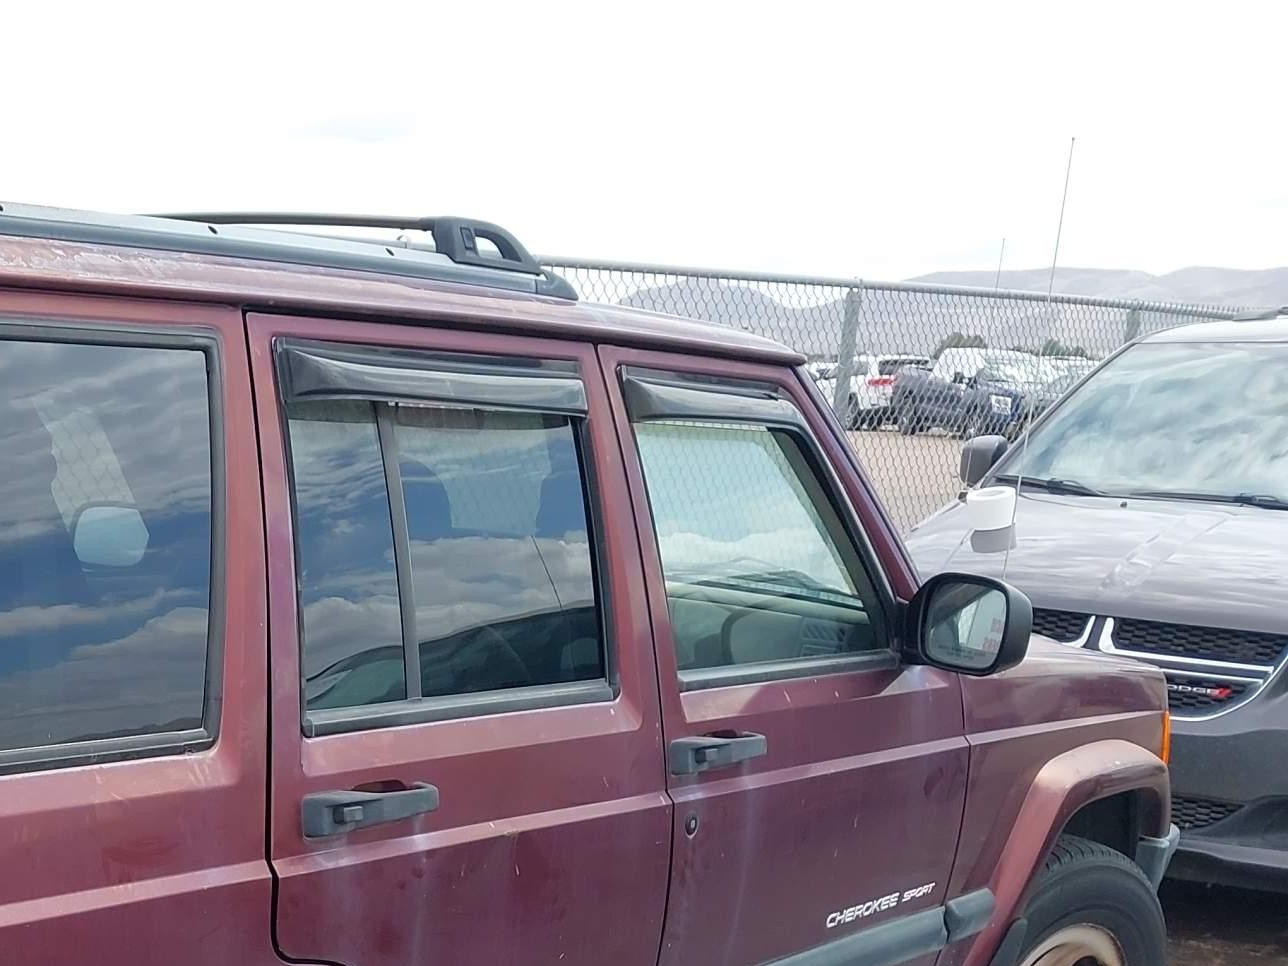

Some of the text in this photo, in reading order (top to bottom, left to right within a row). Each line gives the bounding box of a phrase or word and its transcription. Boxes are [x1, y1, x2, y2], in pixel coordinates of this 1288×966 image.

[1167, 684, 1220, 695] ODGE
[825, 882, 936, 928] CHEROKEE SPORT
